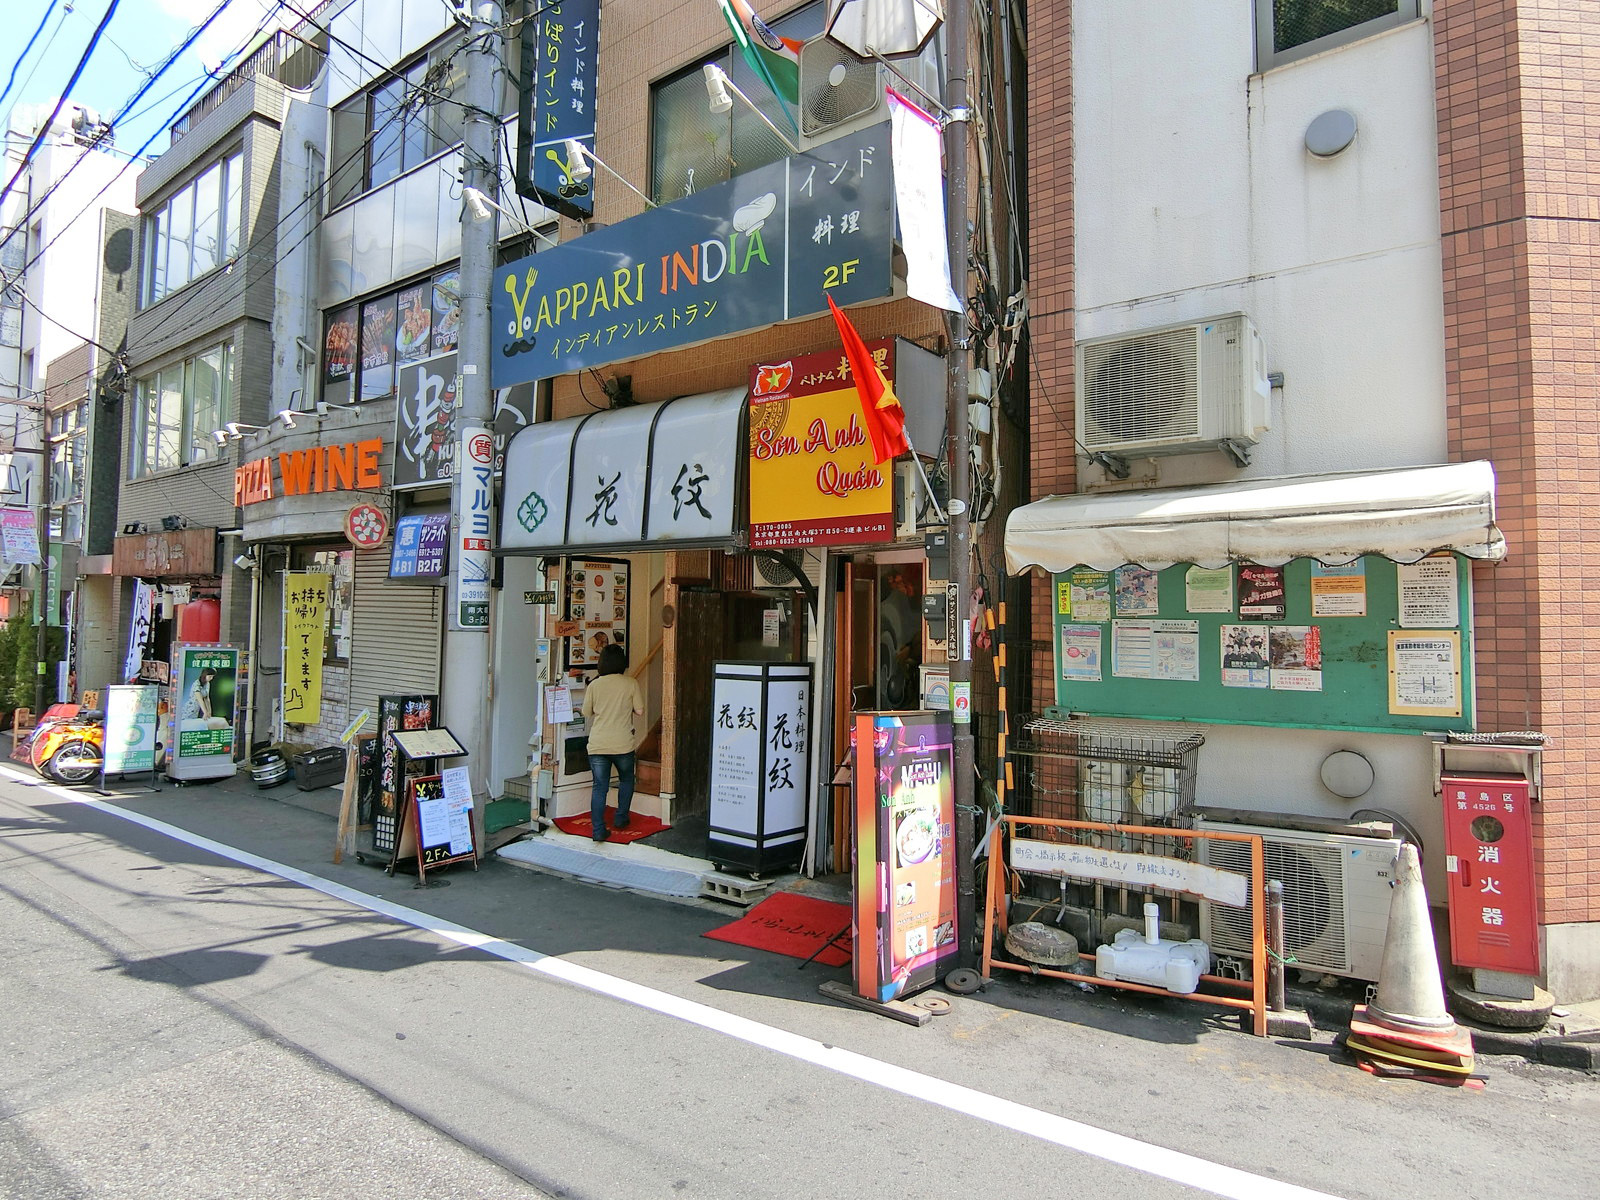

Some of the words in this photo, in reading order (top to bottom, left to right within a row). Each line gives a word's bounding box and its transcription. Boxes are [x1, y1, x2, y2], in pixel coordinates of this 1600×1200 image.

[571, 20, 586, 115] インド料理
[799, 145, 876, 199] インド
[811, 209, 861, 246] 料理
[659, 229, 771, 296] INDIA
[823, 258, 860, 290] 2F
[551, 299, 718, 359] インディアンレストラン
[474, 439, 492, 459] 質
[234, 456, 273, 507] PIZZA
[279, 436, 383, 496] WINE
[816, 461, 884, 497] Quán
[585, 463, 712, 528] 花紋
[421, 525, 446, 542] サンライト
[426, 515, 447, 523] スナック
[401, 561, 412, 572] B1
[418, 560, 430, 573] B2
[291, 587, 325, 604] お持ち
[295, 604, 317, 619] 帰り
[301, 632, 312, 691] できます
[717, 703, 758, 731] 花紋
[794, 689, 806, 753] 日本料理
[768, 713, 795, 793] 花紋
[901, 761, 942, 788] MENU
[1456, 791, 1514, 803] 豊島区
[1477, 845, 1504, 926] 消火器
